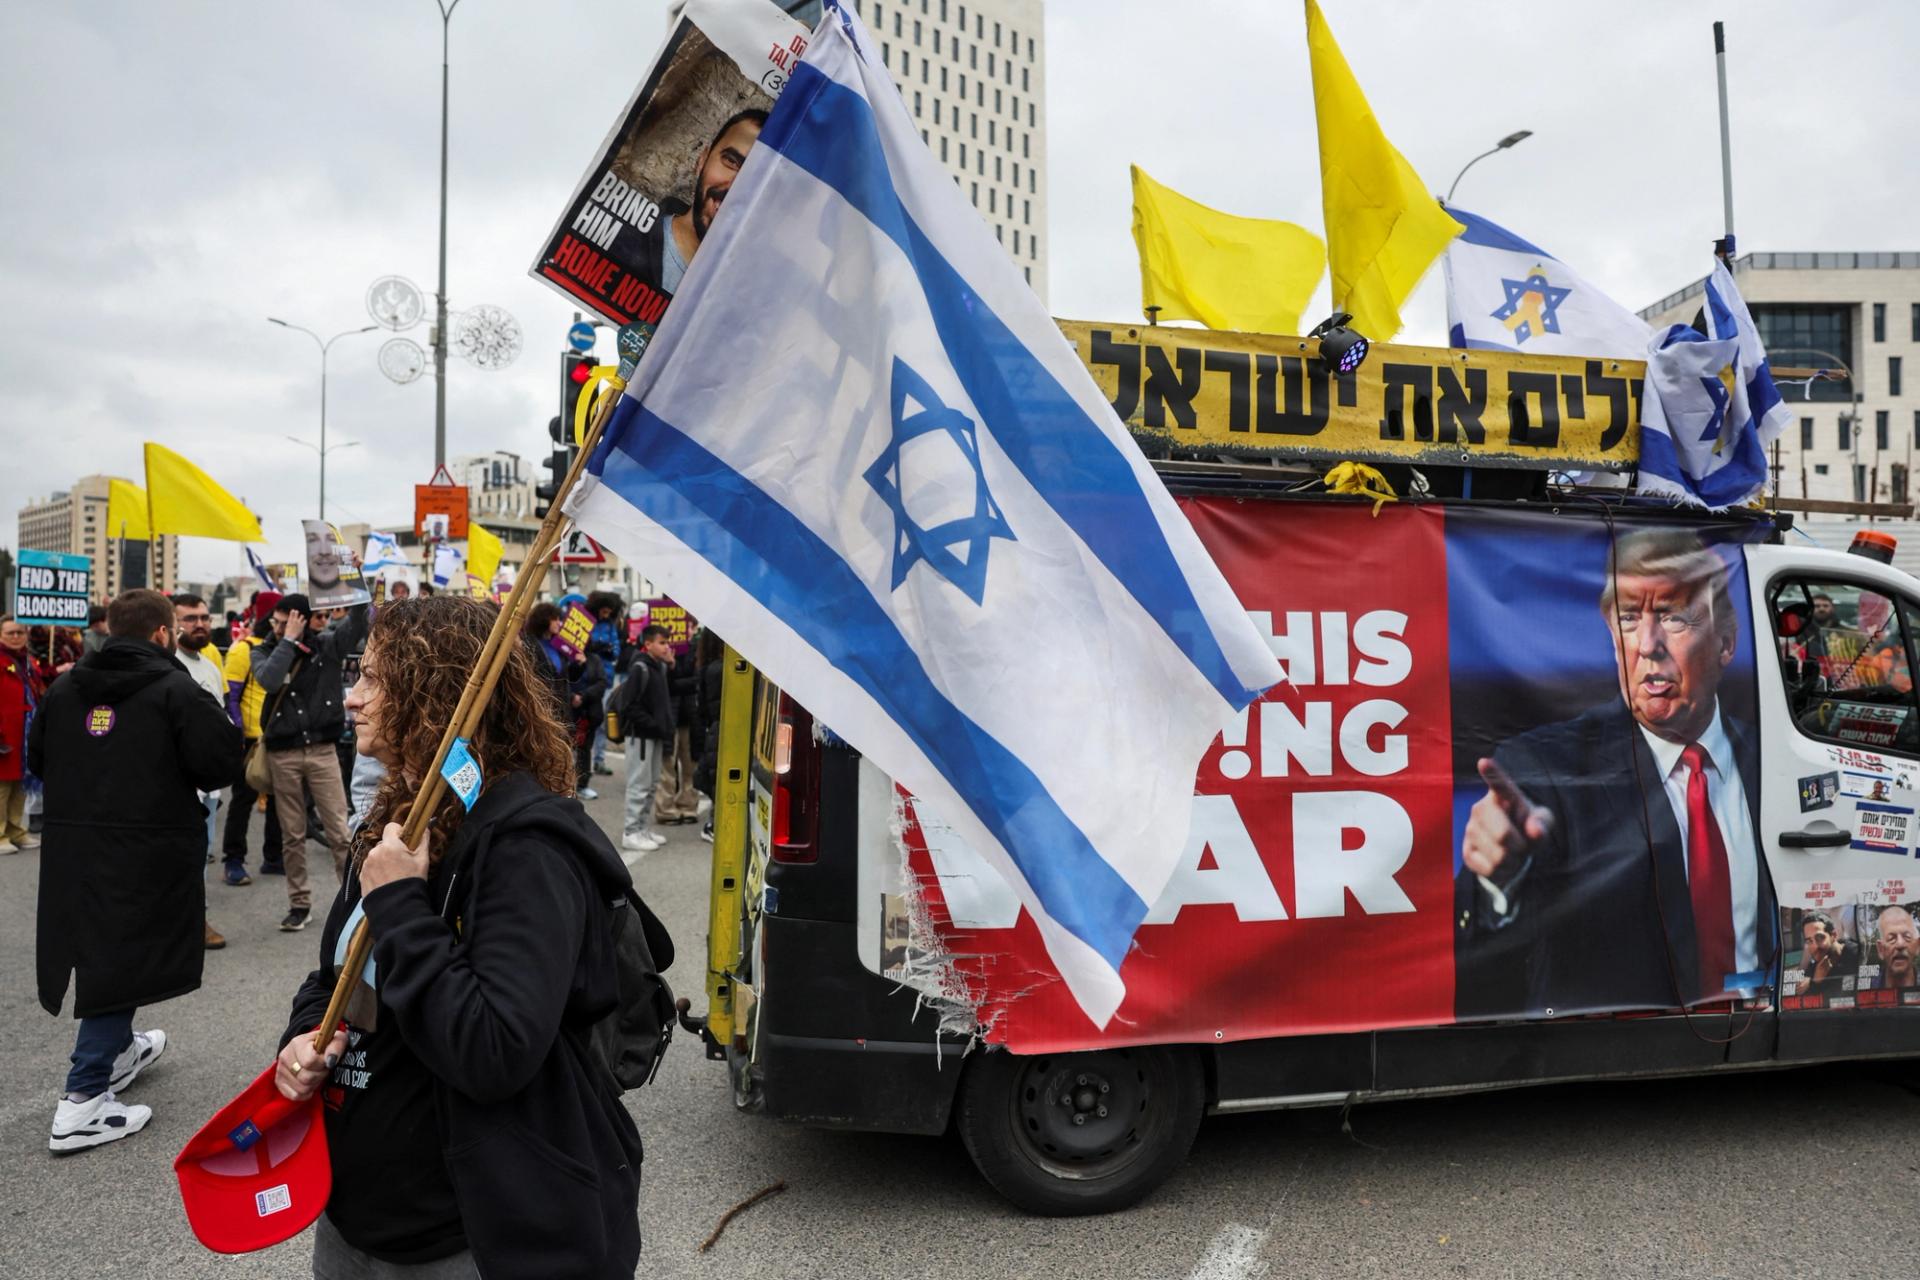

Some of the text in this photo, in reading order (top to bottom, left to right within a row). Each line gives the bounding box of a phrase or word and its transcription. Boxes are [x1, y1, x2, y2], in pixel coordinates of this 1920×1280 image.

[768, 43, 789, 71] TAL
[590, 170, 660, 234] BRING
[571, 200, 624, 252] HIM
[553, 234, 670, 325] HOME NOW
[1091, 330, 1358, 436] ישראל
[1379, 363, 1487, 445] את
[20, 566, 88, 593] END THE
[17, 595, 88, 618] BLOODSHED
[1861, 812, 1880, 825] אותם
[1883, 828, 1905, 841] הביתה
